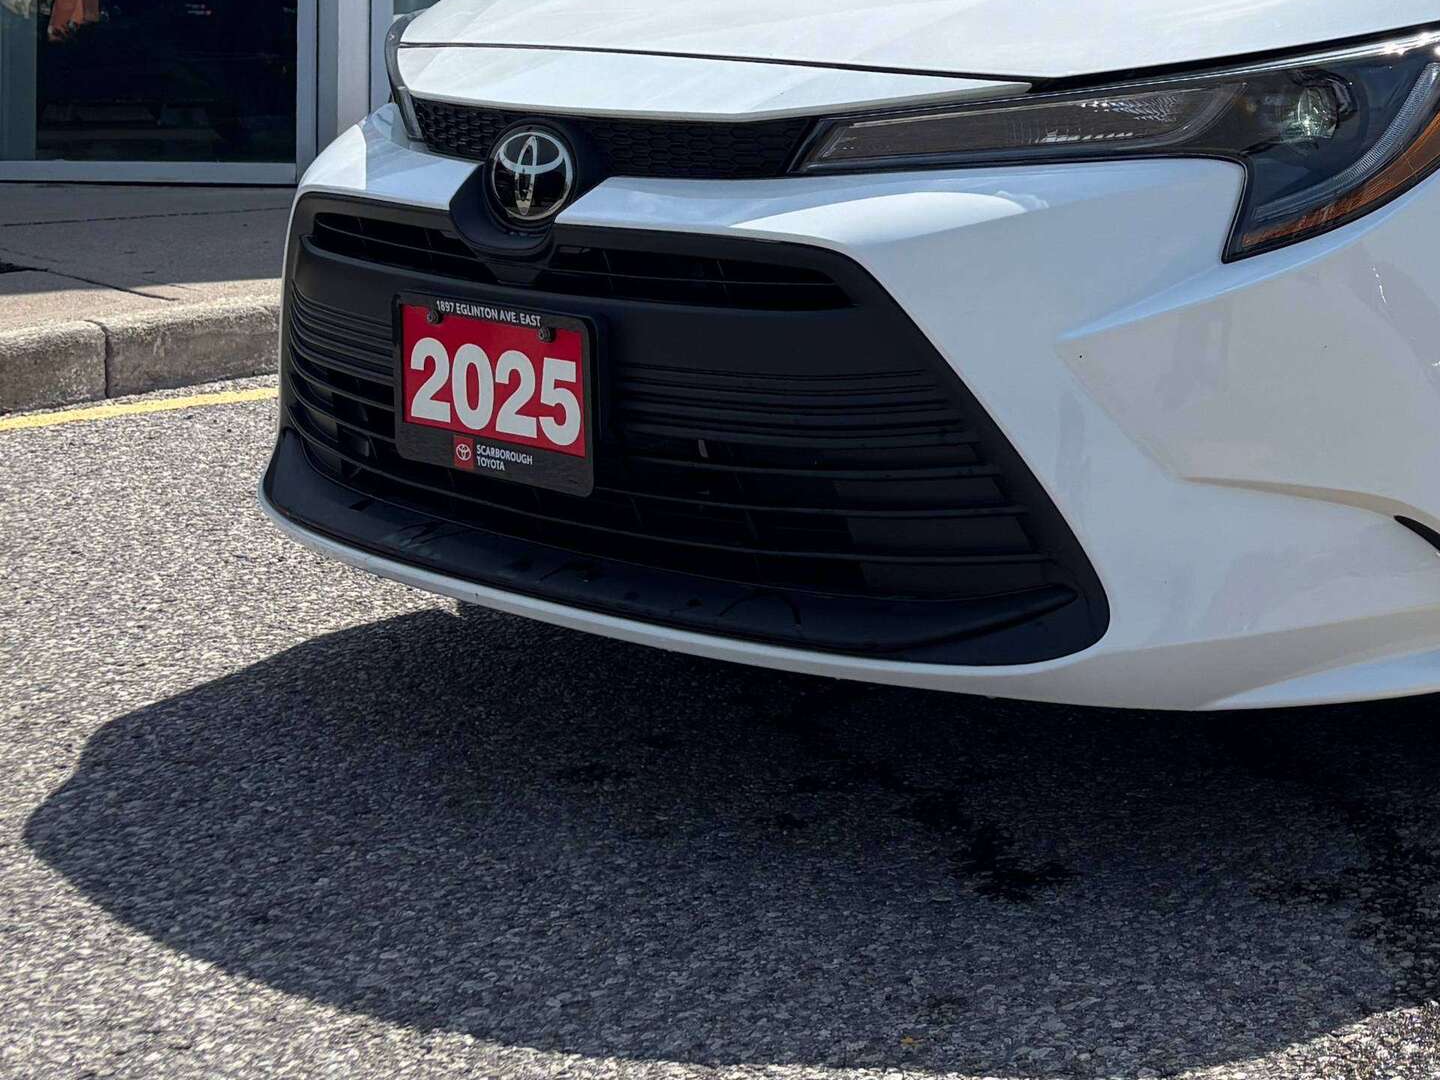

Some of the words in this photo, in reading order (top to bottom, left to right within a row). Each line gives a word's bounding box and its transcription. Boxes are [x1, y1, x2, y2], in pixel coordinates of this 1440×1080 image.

[436, 300, 454, 312] 1897
[456, 303, 497, 320] EGLINTON
[500, 310, 520, 323] AVE.
[520, 313, 541, 327] EAST
[410, 337, 581, 446] 2025
[476, 445, 533, 465] SCARBOROUGH
[476, 455, 505, 471] TOYOTA
